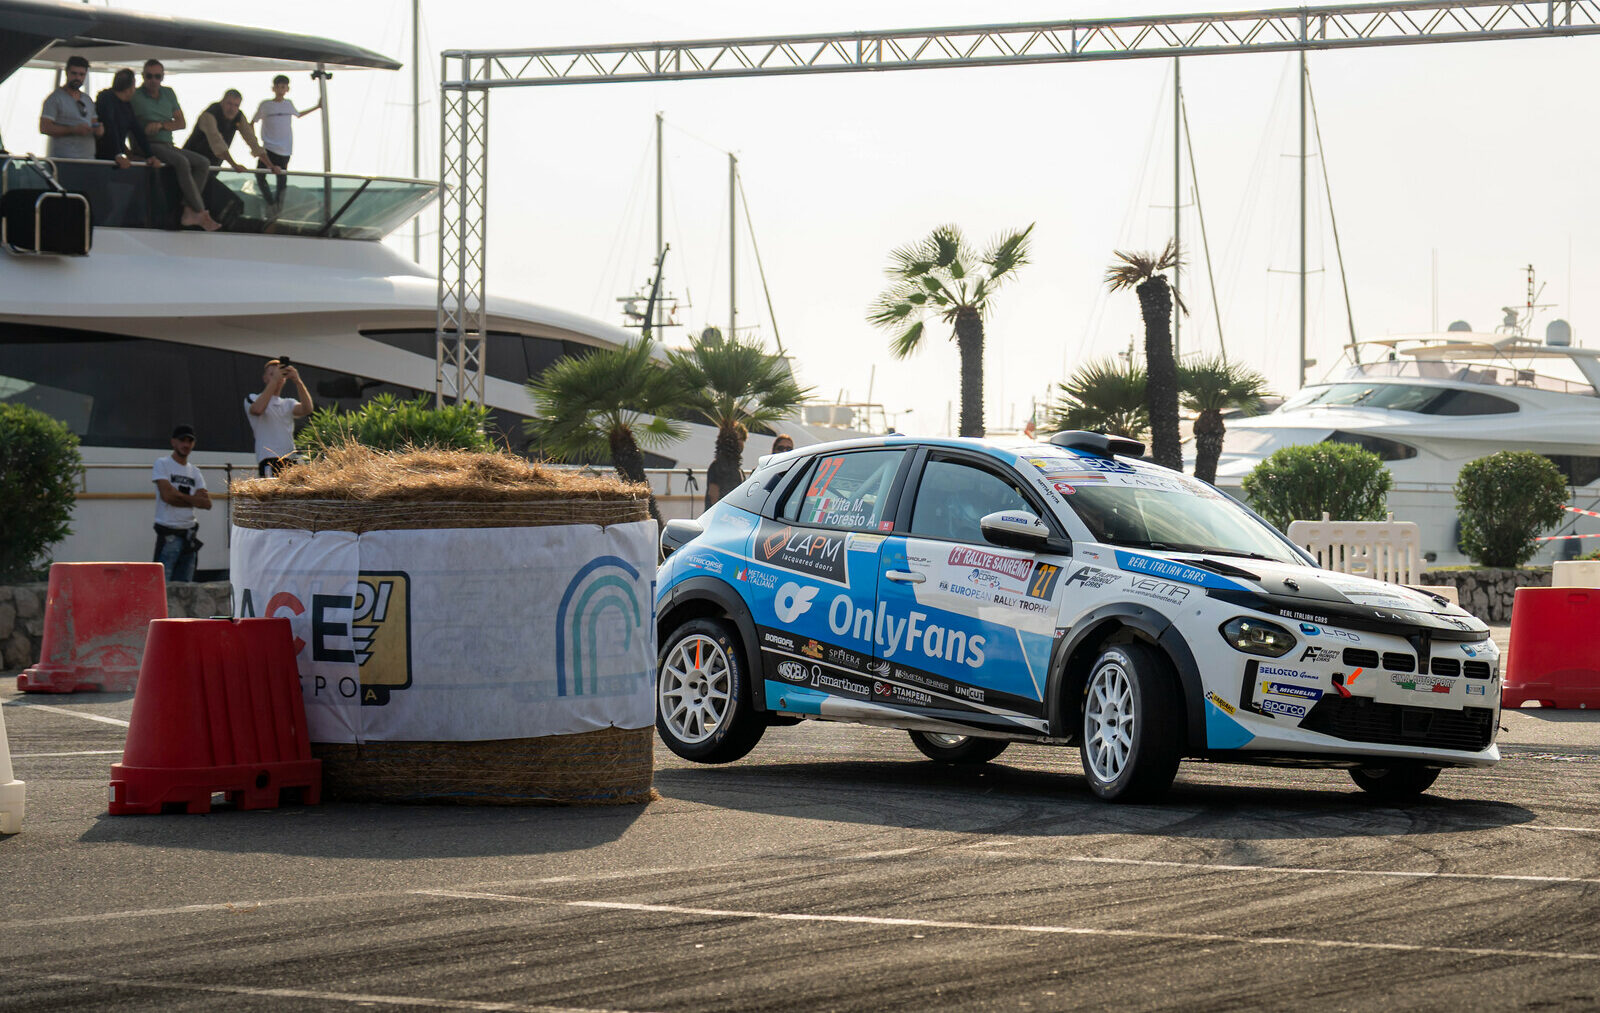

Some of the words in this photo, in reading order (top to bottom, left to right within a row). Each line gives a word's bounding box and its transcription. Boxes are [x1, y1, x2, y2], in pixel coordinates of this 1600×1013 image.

[806, 457, 846, 497] 27
[831, 497, 850, 511] Vita
[851, 498, 864, 513] M.
[824, 511, 866, 527] Foresto
[866, 514, 878, 528] A.
[785, 531, 843, 562] LAPM
[781, 552, 814, 568] lacquered
[814, 559, 834, 572] doors
[962, 548, 992, 569] RALLYE
[991, 556, 1031, 578] SANREMO
[1127, 556, 1148, 570] REAL
[1148, 560, 1182, 577] ITALIAN
[1181, 568, 1207, 583] CARS
[747, 569, 779, 584] METALLOY
[747, 575, 775, 589] ITALIANA
[1031, 563, 1058, 599] 27
[1130, 576, 1191, 600] VEMA
[950, 583, 992, 601] EUROPEAN
[993, 594, 1017, 607] RALLY
[1019, 600, 1050, 614] TROPHY
[1279, 609, 1293, 618] REAL
[1293, 611, 1314, 621] ITALIAN
[1314, 615, 1328, 625] CARS
[828, 593, 987, 669] OnlyFans
[1259, 666, 1299, 678] BELLOTTO
[1411, 674, 1456, 689] AUTOSPORT
[819, 674, 870, 696] smarthome
[1279, 686, 1317, 698] MICHELIN
[892, 686, 932, 704] STAMPERIA
[1263, 699, 1305, 716] sparco
